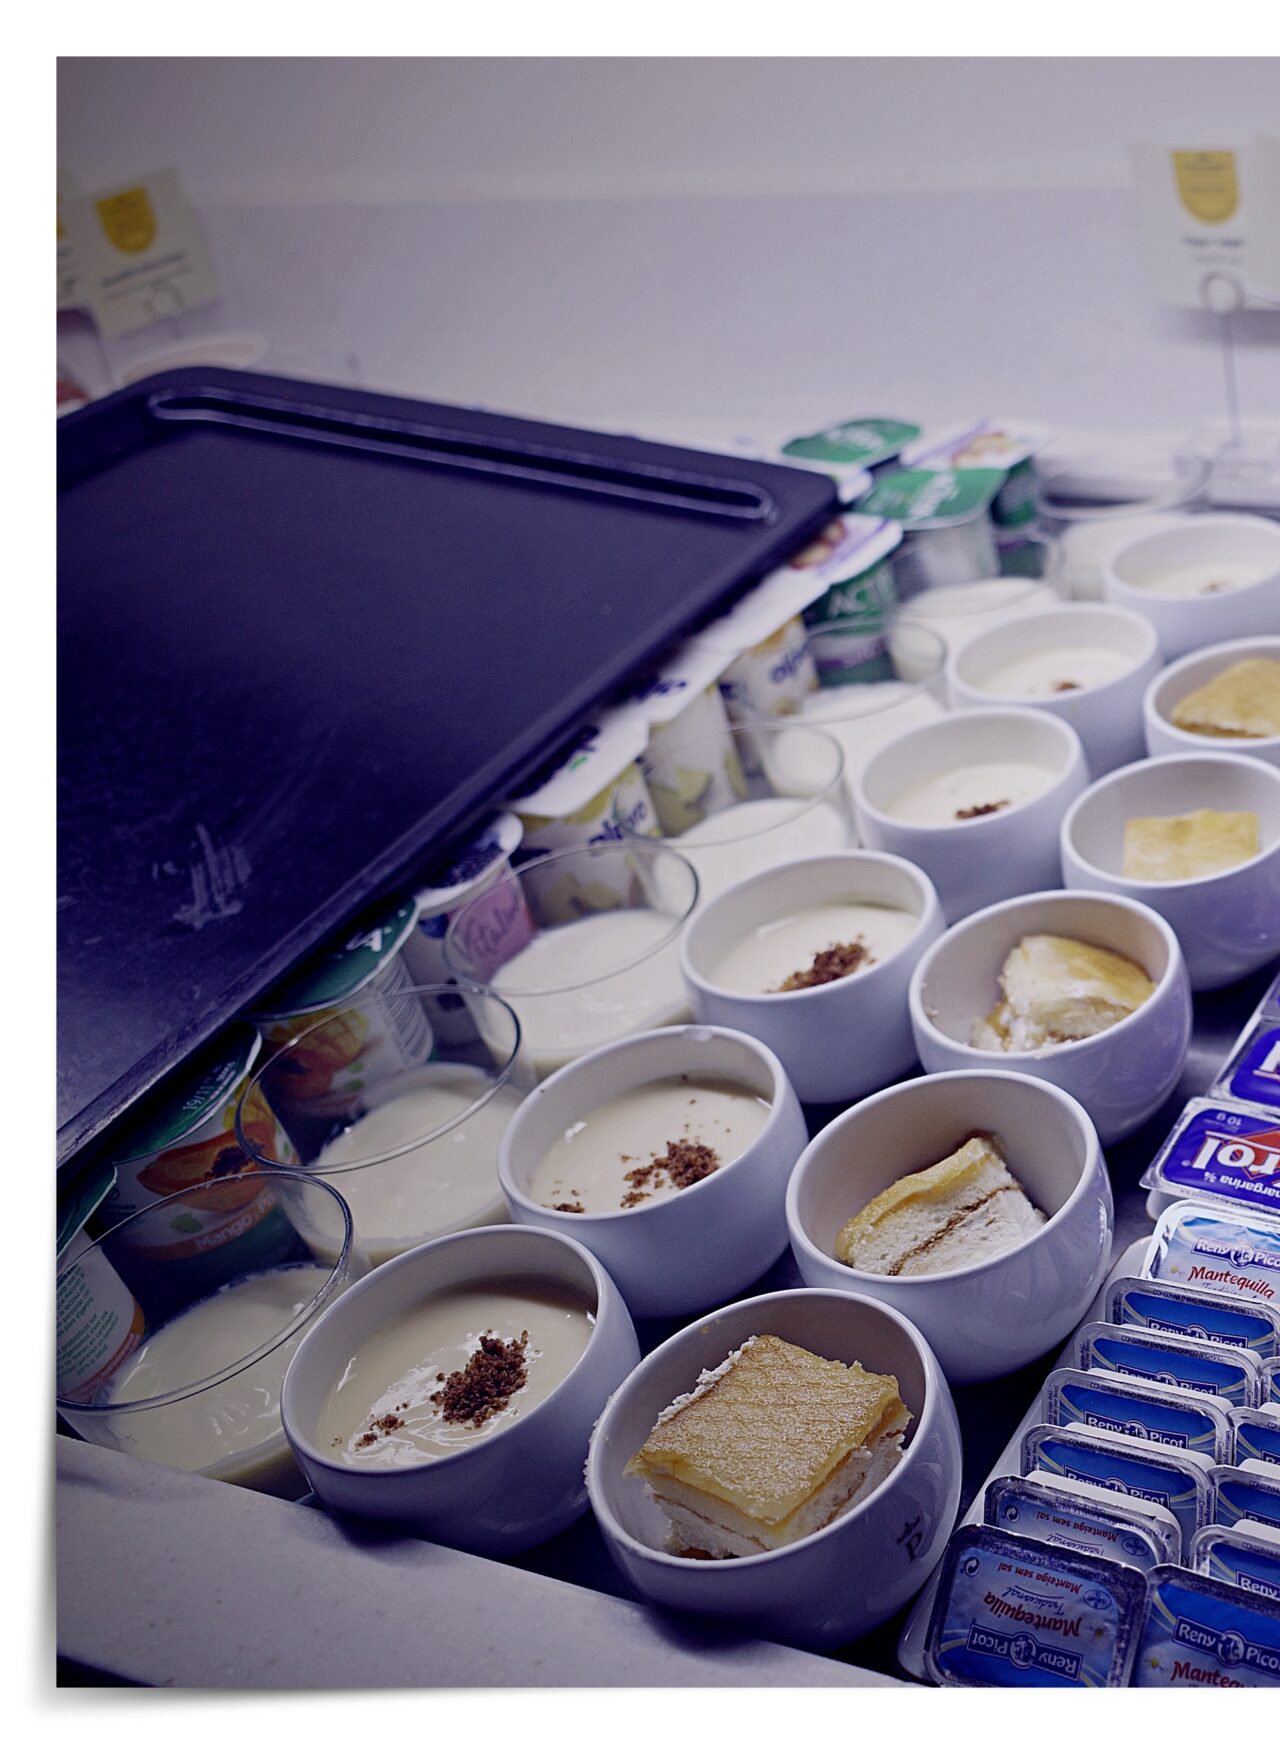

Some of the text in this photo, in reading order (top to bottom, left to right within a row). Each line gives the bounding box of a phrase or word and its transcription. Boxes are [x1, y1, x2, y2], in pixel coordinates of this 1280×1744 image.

[1227, 1116, 1240, 1125] 10
[1195, 1240, 1229, 1258] Reny
[1188, 1266, 1275, 1299] Mantequilla
[1150, 1430, 1185, 1447] Picot
[1241, 1577, 1277, 1597] Reny
[983, 1591, 1082, 1637] Mantequilla
[1178, 1625, 1215, 1647] Reny
[972, 1631, 1078, 1674] Reny Picot
